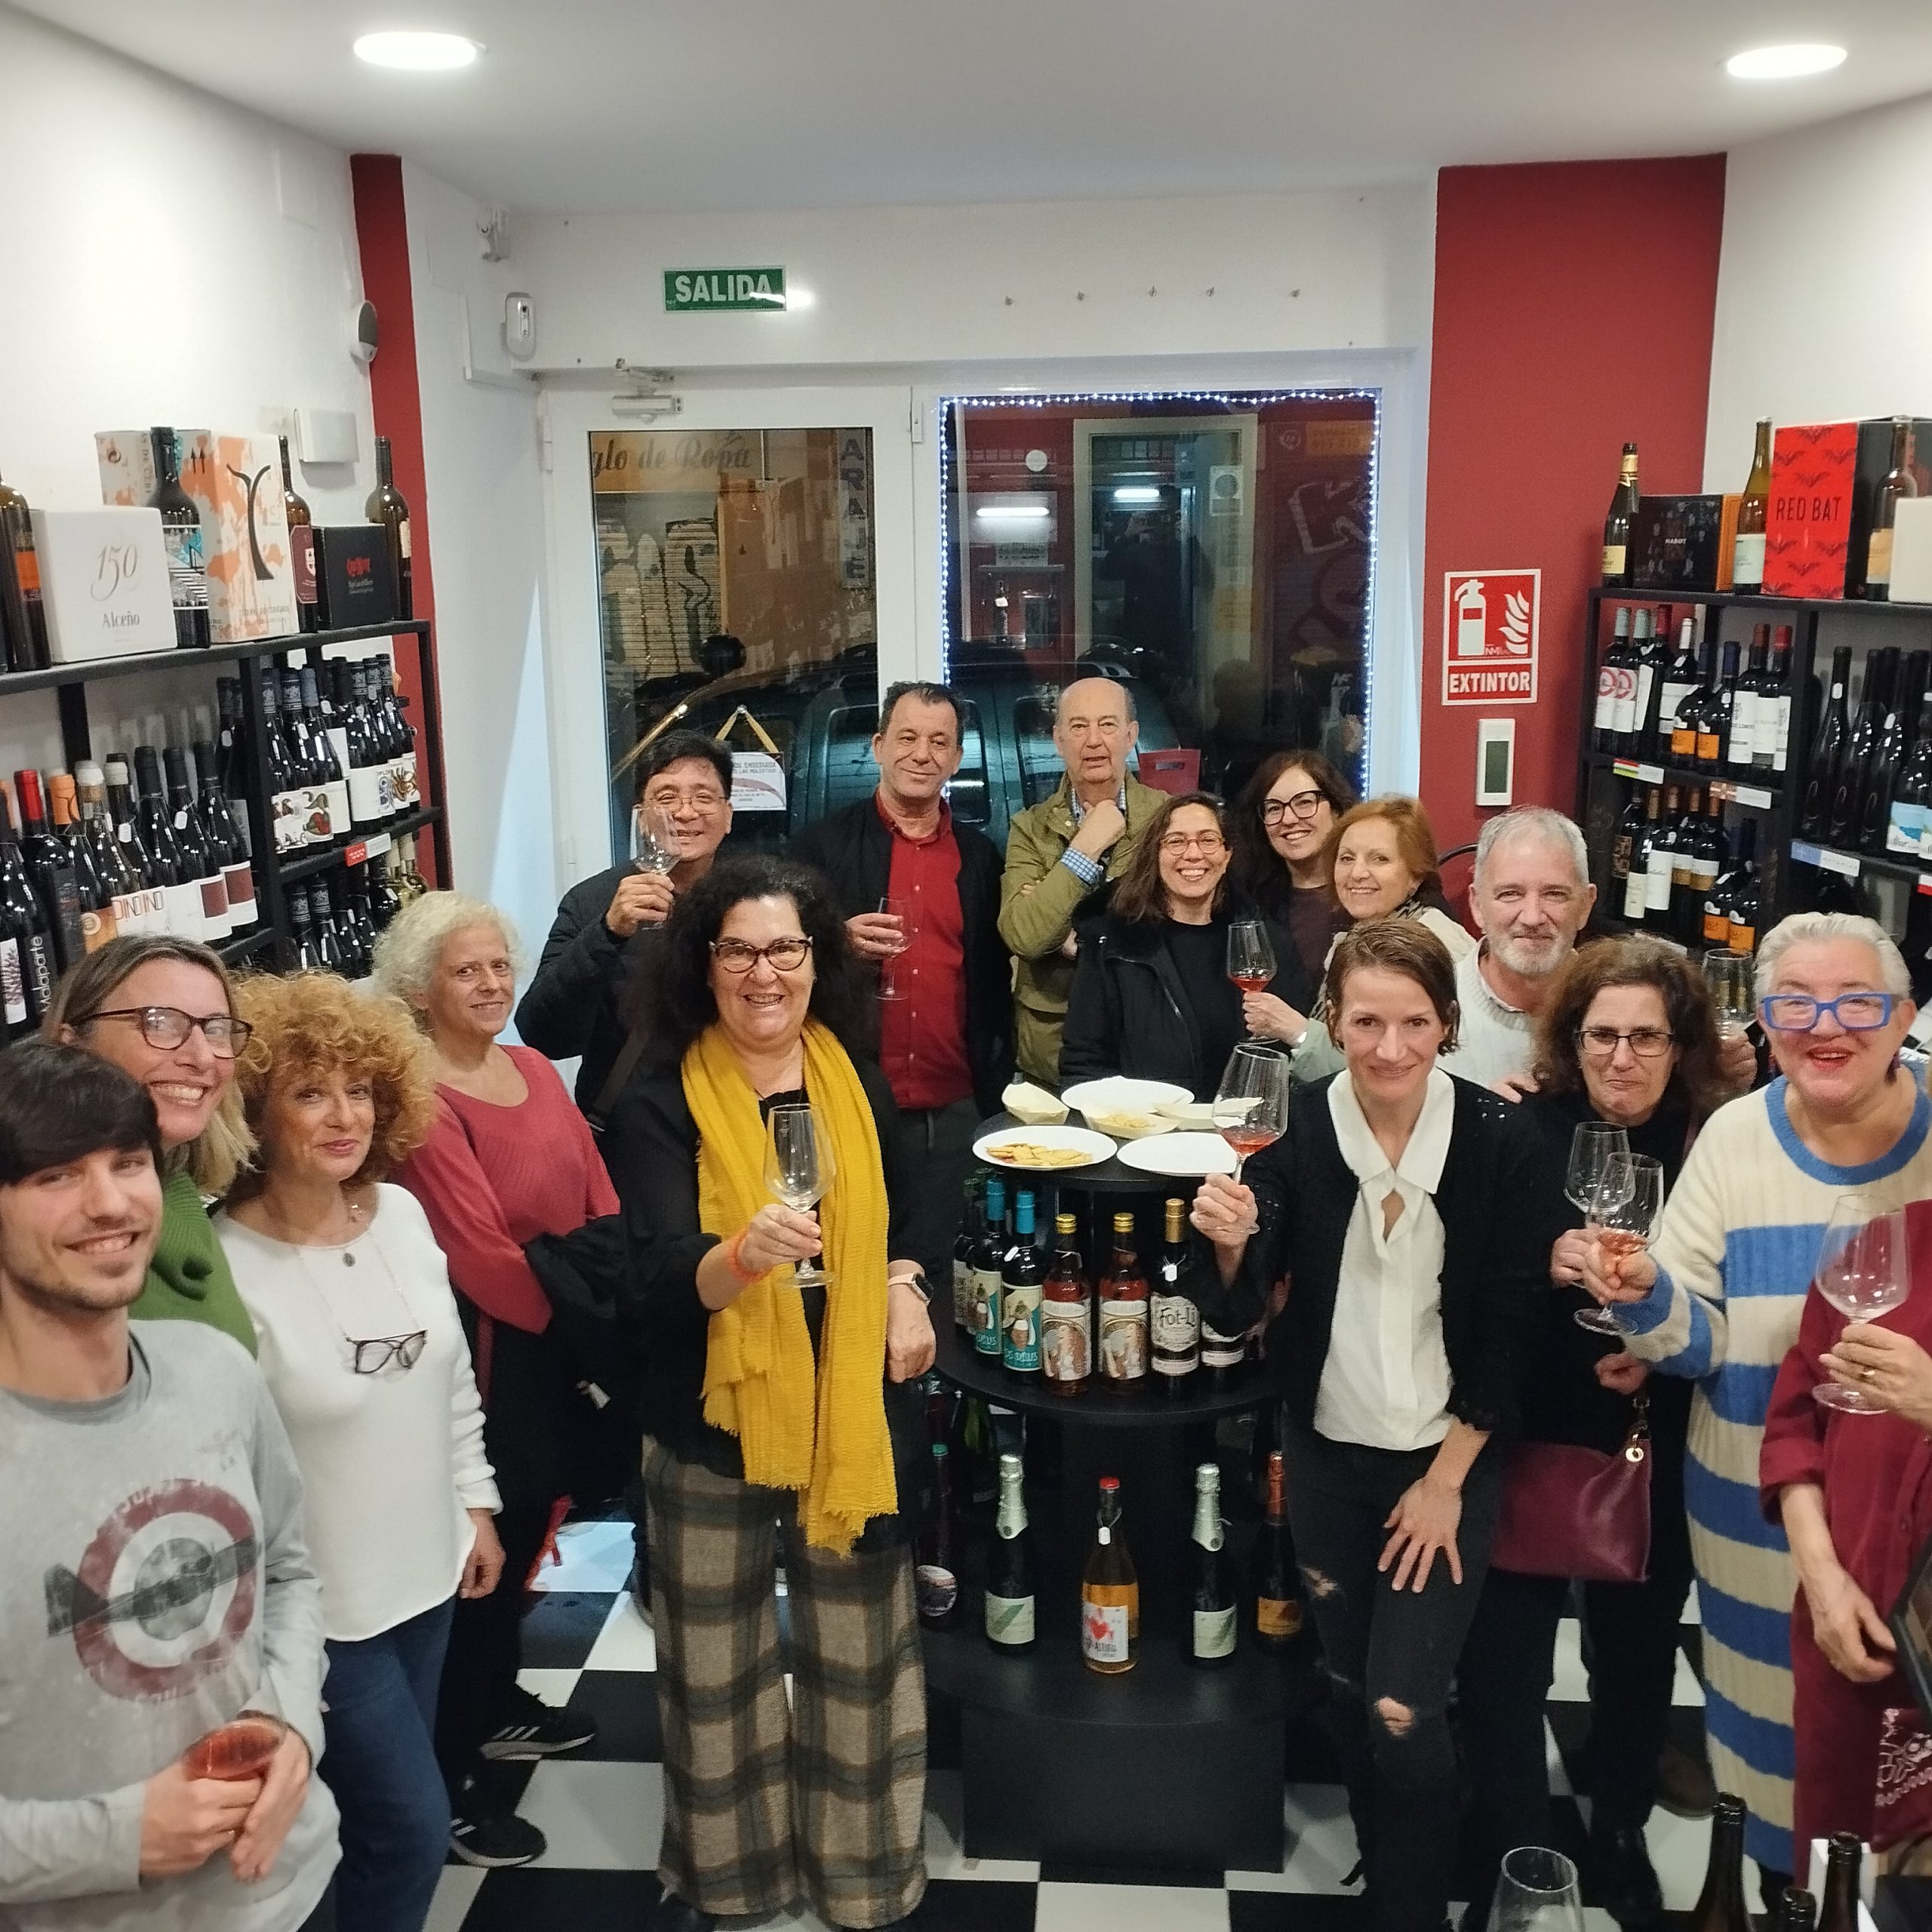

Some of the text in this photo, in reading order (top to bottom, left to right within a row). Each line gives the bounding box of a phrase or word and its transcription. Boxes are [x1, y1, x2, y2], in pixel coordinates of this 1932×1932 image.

[675, 274, 771, 302] SALIDA
[1776, 497, 1841, 521] RED BAT
[91, 544, 138, 601] 150
[103, 611, 140, 628] Alceño
[1449, 672, 1531, 693] EXTINTOR
[29, 935, 51, 1013] Malaparte
